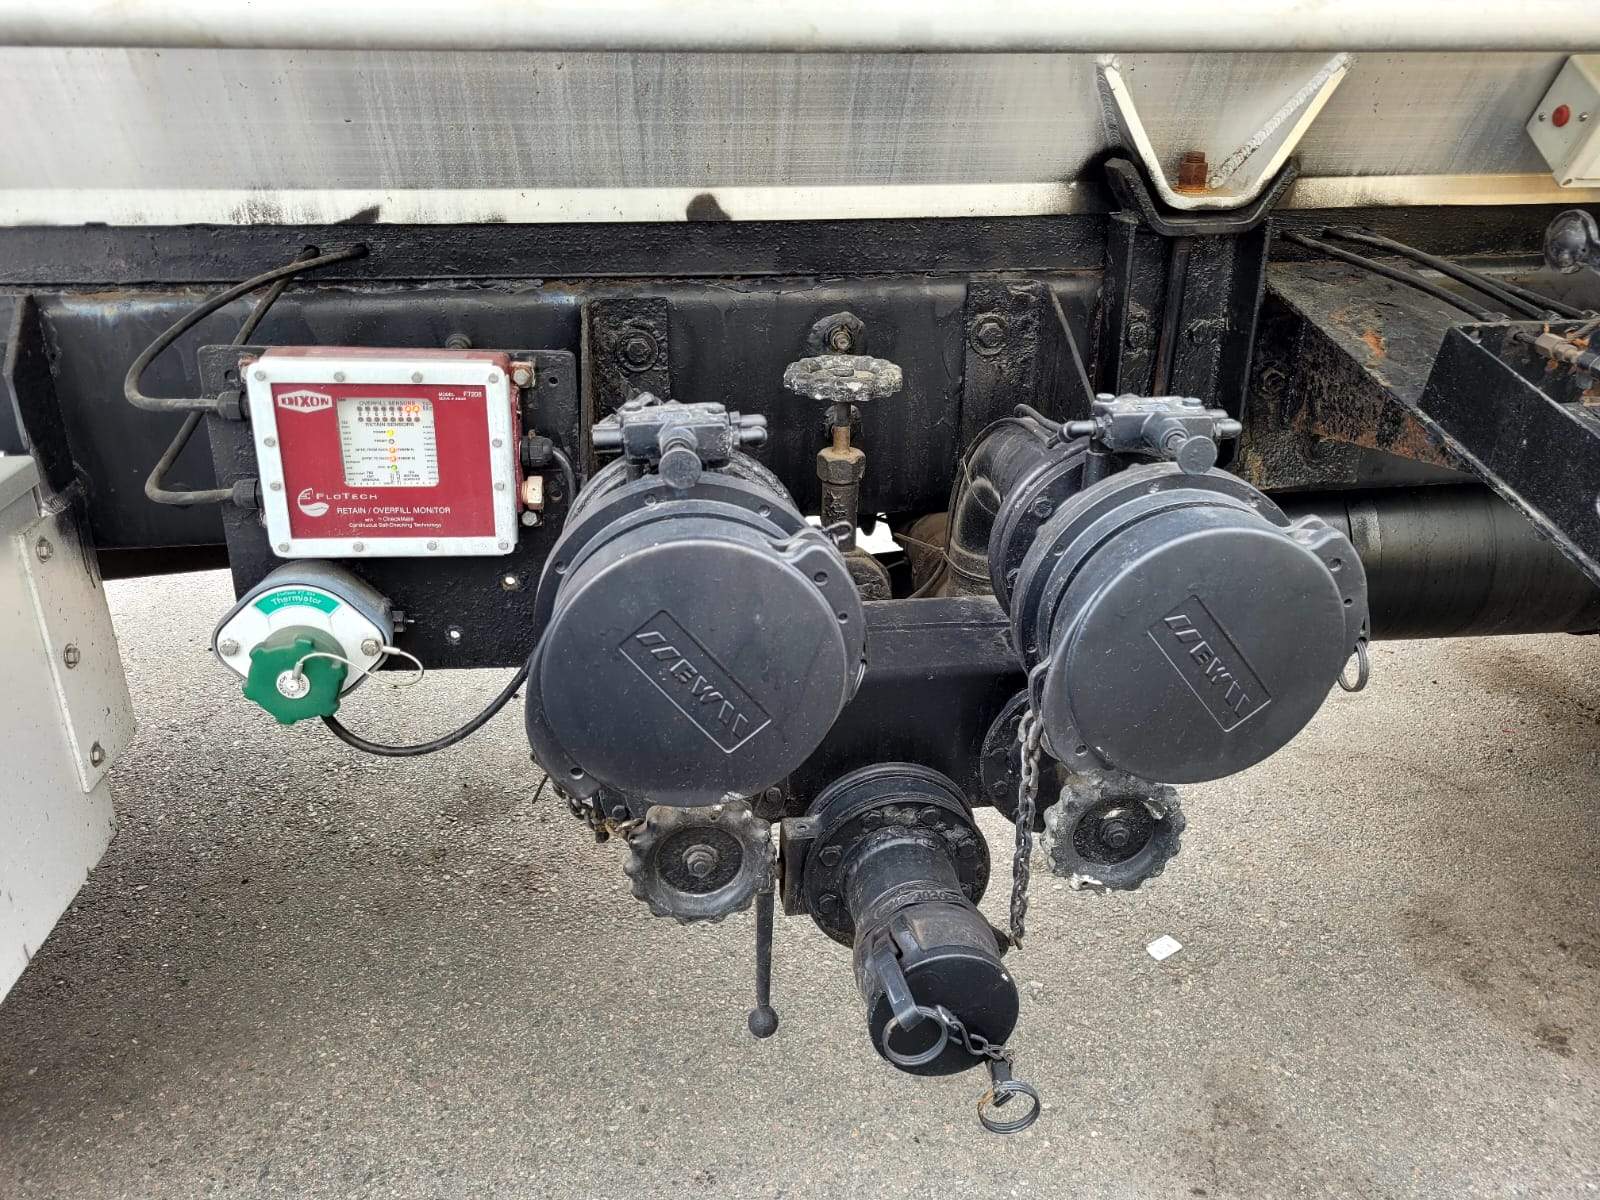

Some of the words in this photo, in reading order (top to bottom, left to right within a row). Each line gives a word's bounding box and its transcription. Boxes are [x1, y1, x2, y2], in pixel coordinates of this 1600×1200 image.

[281, 396, 329, 407] DIXON
[372, 506, 412, 514] OVERFILL
[412, 506, 451, 514] MONITOR
